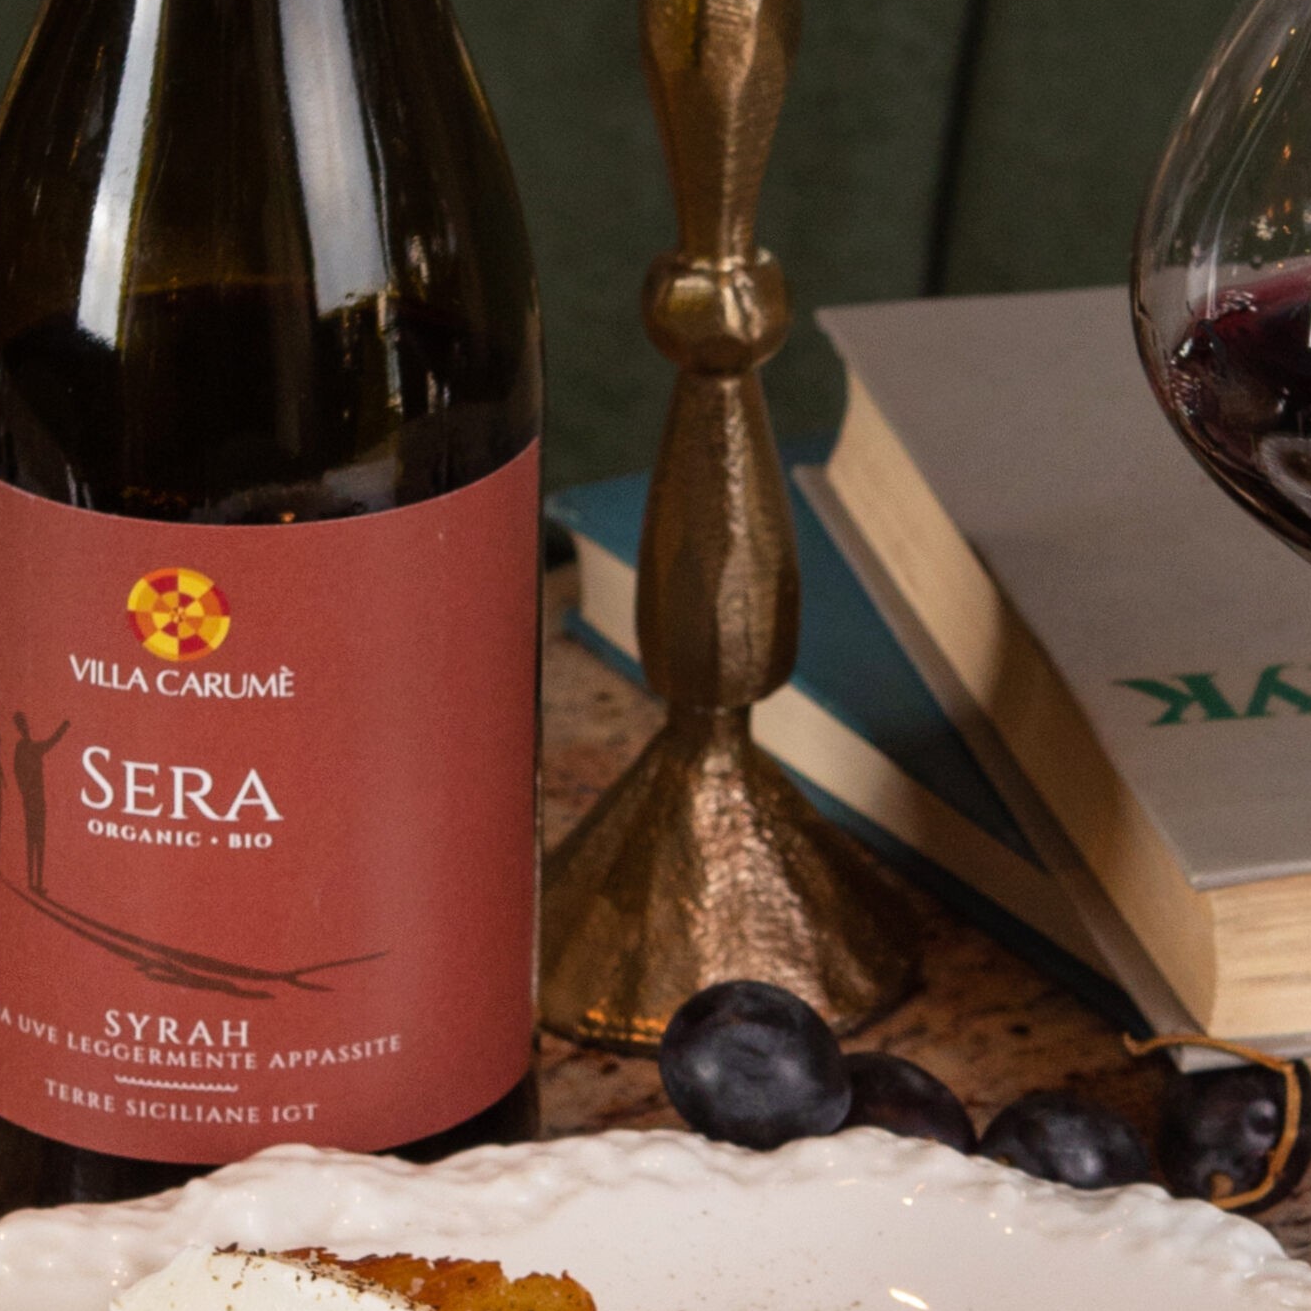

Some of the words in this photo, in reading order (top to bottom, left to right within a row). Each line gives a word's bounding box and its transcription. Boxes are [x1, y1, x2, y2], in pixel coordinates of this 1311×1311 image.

[68, 653, 150, 694] VILLA
[155, 665, 296, 700] CARUMÈ
[80, 745, 285, 822] SERA
[87, 818, 201, 848] ORGANIC
[227, 832, 274, 850] BIO
[17, 1015, 59, 1045] UVE
[66, 1030, 258, 1070] LEGGERMENTE
[268, 1033, 402, 1069] APPASSITE
[103, 1008, 250, 1048] SYRAH
[44, 1078, 116, 1113] TERRE
[125, 1097, 260, 1125] SICILIANE
[271, 1102, 320, 1125] IGT
